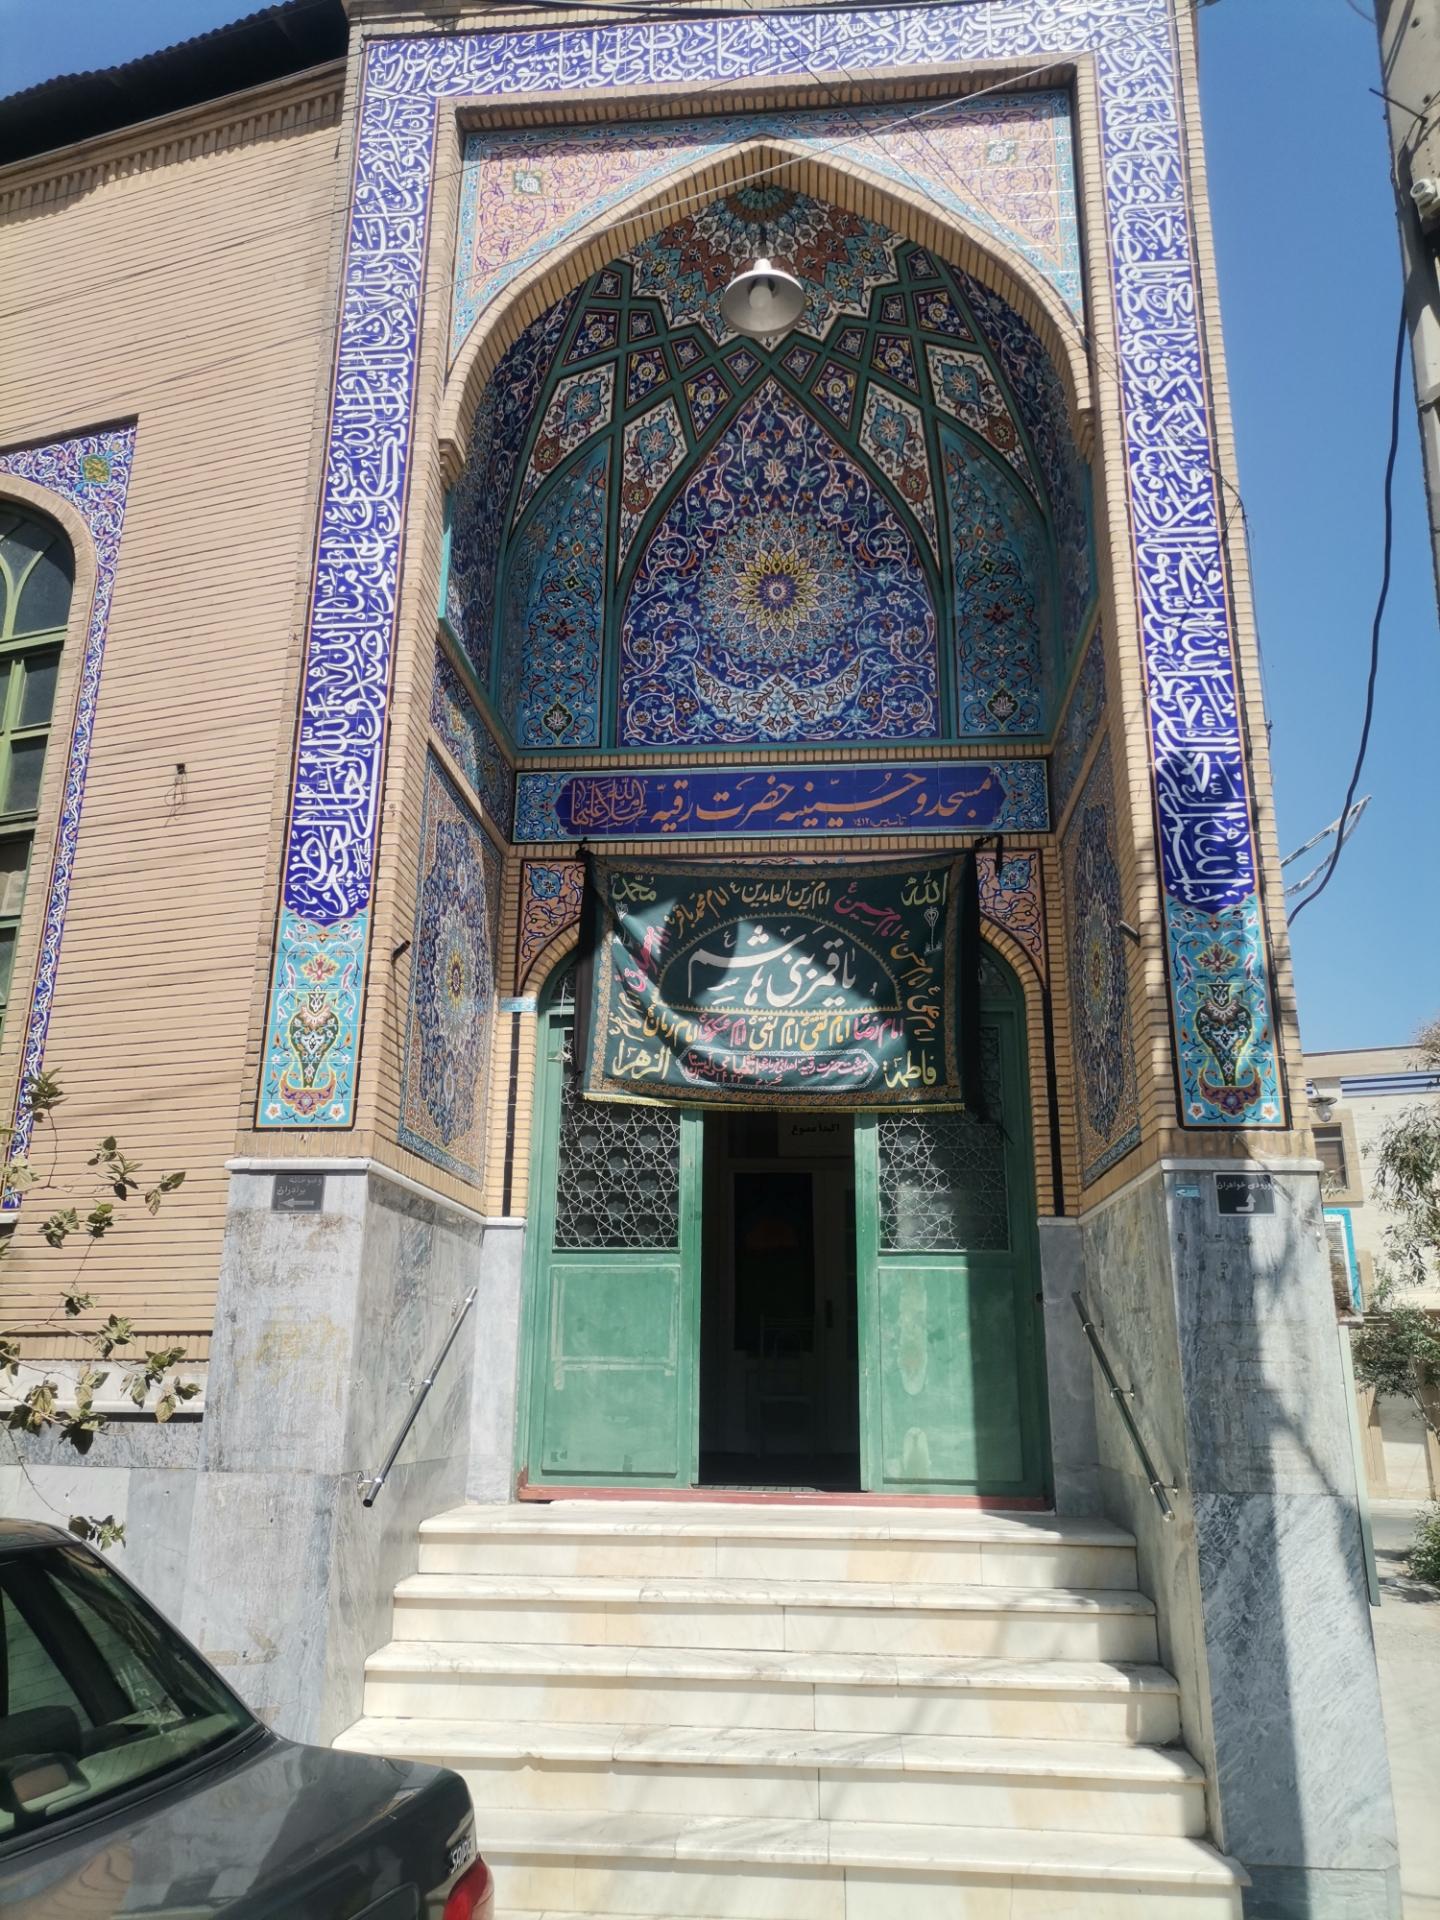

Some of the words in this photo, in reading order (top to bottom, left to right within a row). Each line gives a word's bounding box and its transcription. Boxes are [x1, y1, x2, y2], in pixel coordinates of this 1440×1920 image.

[697, 774, 796, 829] حضرت
[910, 792, 928, 816] و
[924, 777, 992, 818] مسجد
[900, 871, 950, 907] الله
[788, 937, 845, 1008] قمر
